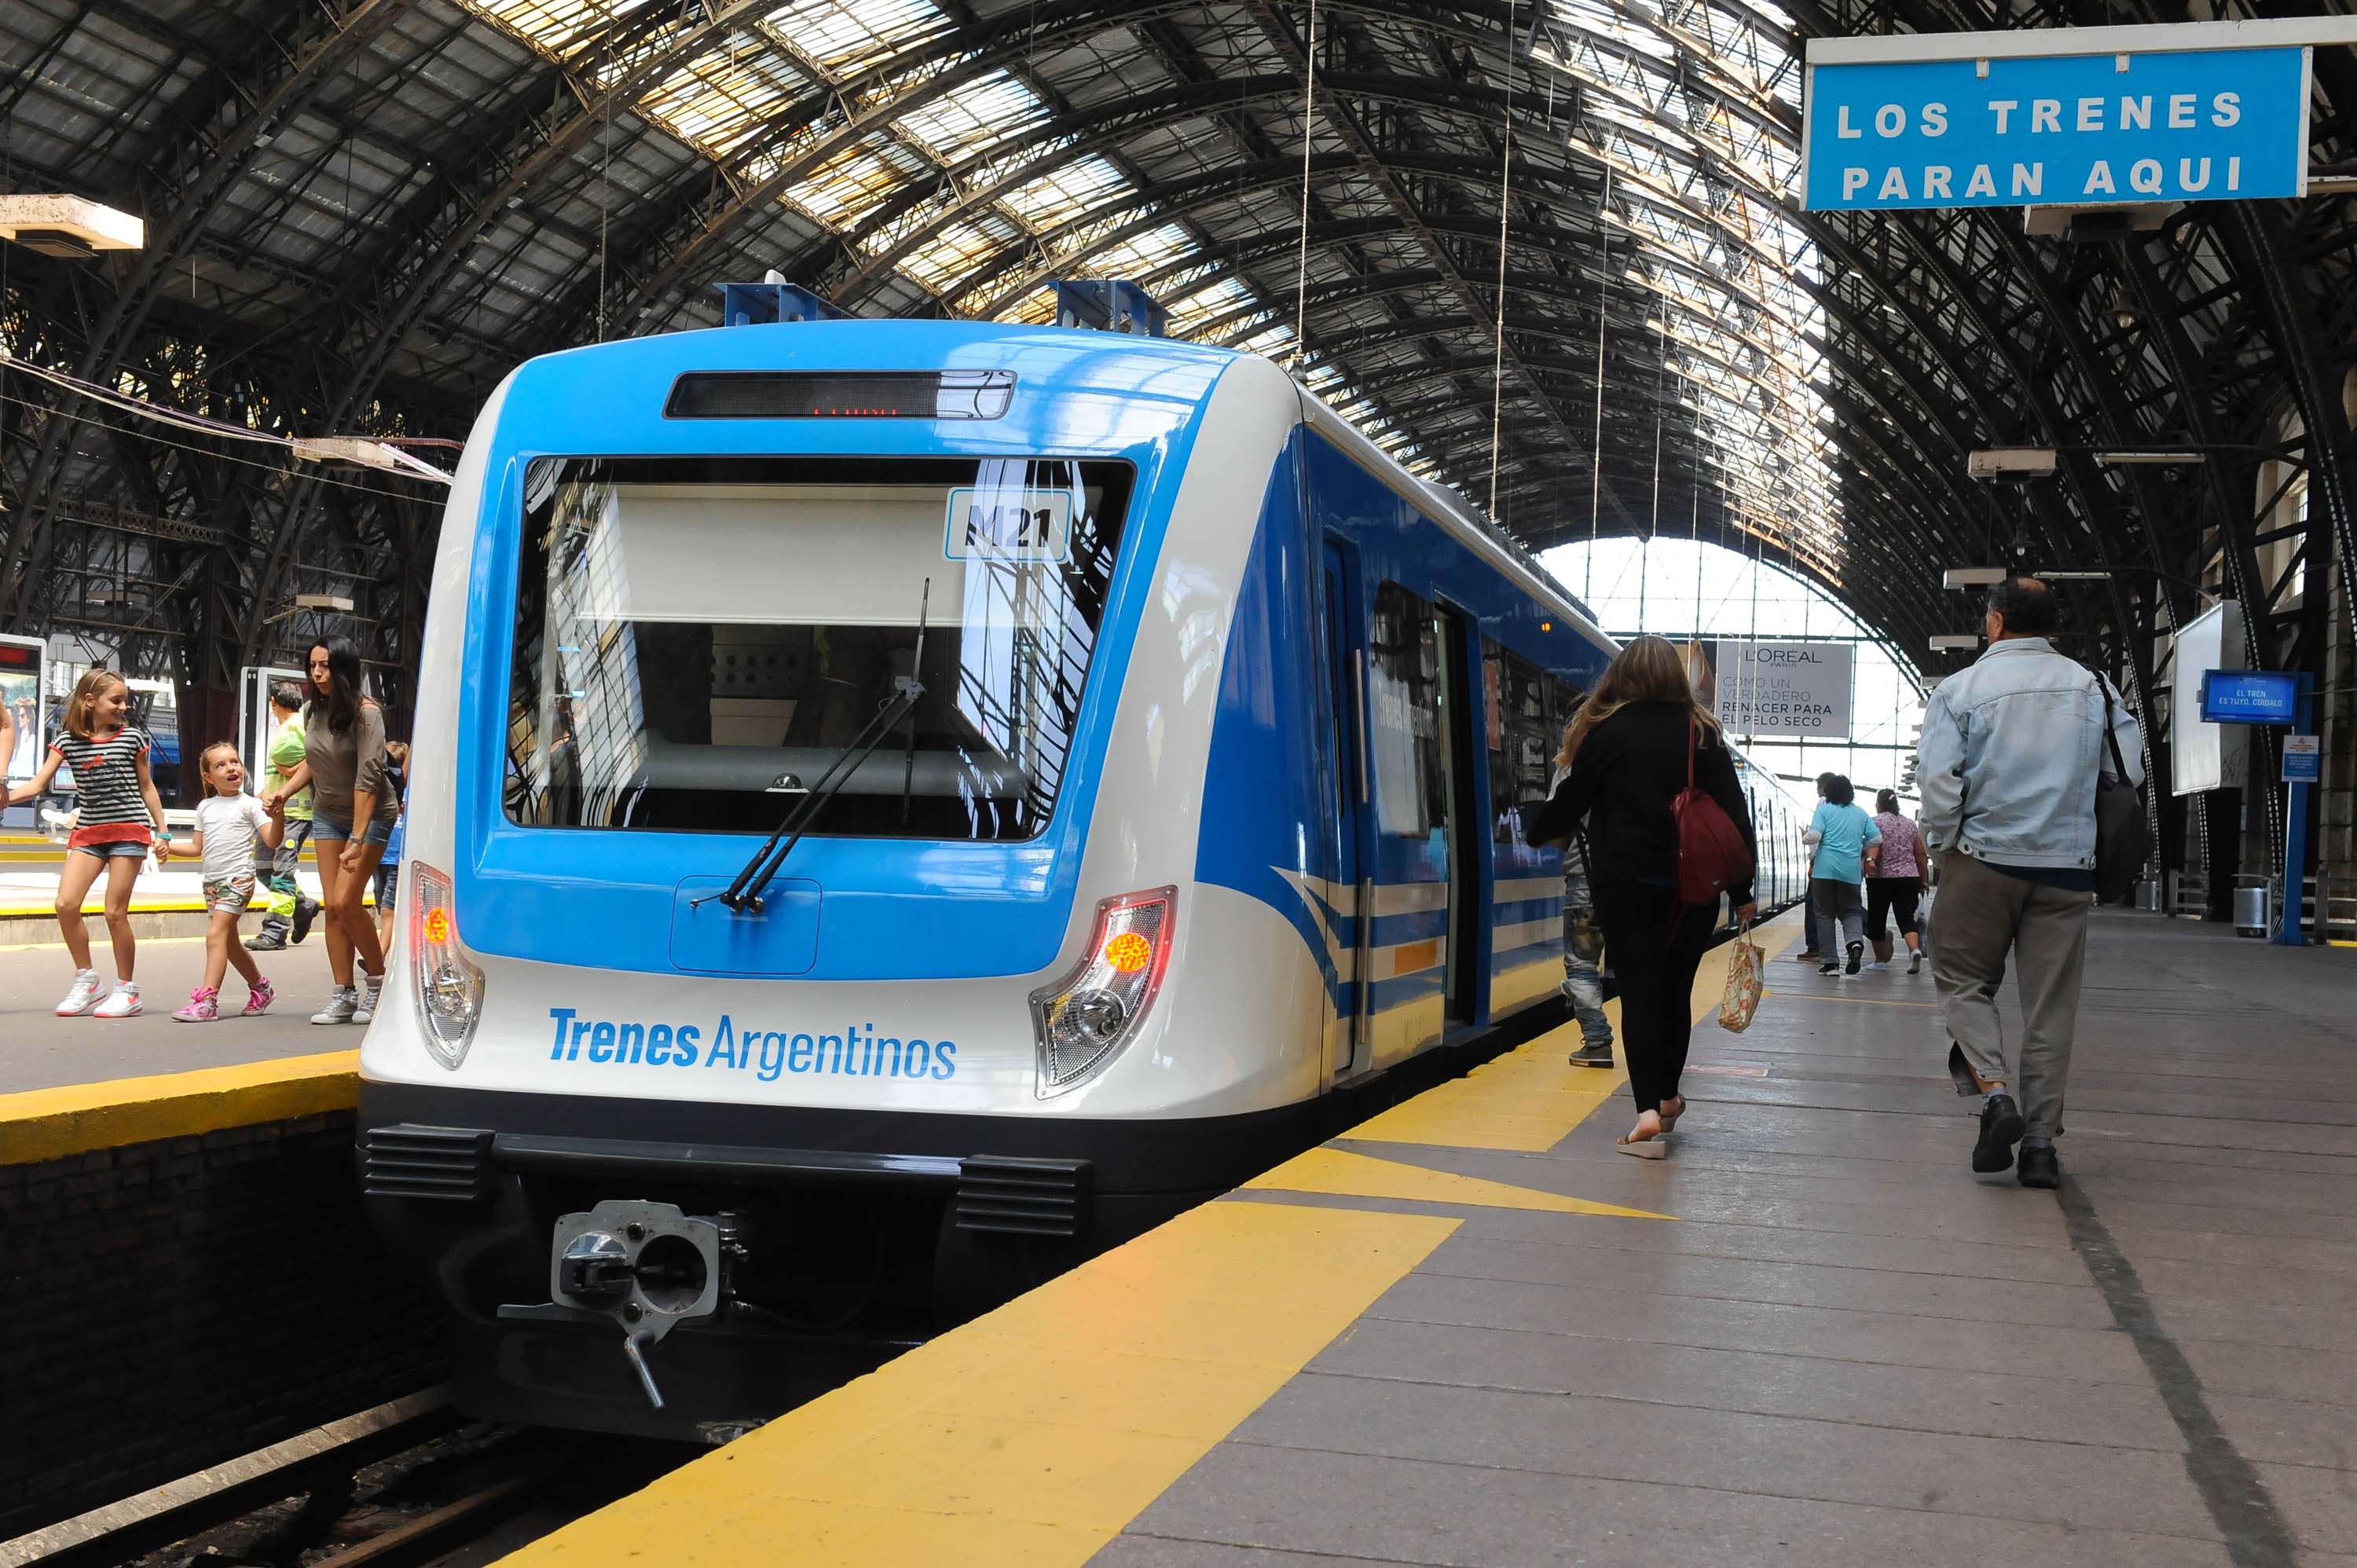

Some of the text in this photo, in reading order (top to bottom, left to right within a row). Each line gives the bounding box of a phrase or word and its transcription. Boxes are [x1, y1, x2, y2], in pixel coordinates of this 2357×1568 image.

[1837, 91, 2243, 139] LOS TRENES
[1842, 156, 2242, 201] PARAN AQUI
[965, 504, 1051, 548] M21
[1723, 676, 1791, 688] COMO UN
[1723, 689, 1812, 702] VERDADERO
[2247, 690, 2267, 698] TREN
[1722, 702, 1832, 715] RENACER PARA
[1722, 714, 1822, 727] EL PELO SECO
[549, 1007, 957, 1083] Trenes Argentinos
